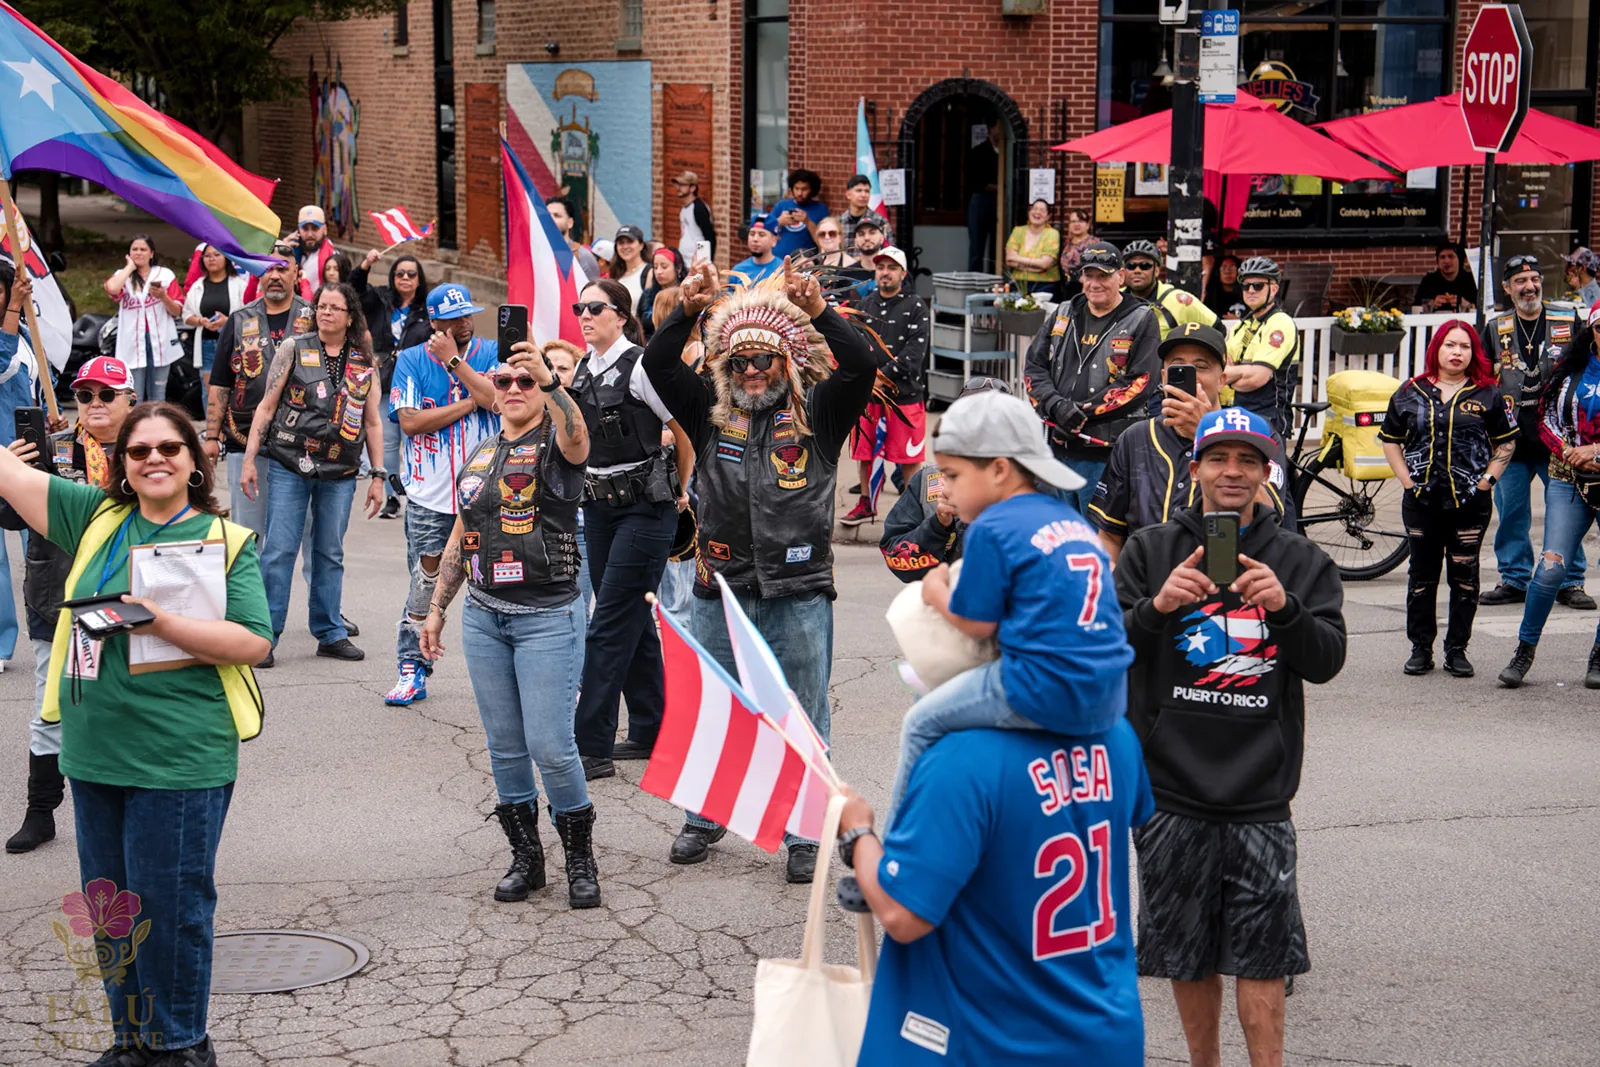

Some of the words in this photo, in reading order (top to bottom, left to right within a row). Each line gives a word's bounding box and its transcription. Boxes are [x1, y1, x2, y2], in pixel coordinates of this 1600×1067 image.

[1224, 14, 1235, 23] bus
[1224, 24, 1237, 33] stop
[1465, 51, 1516, 105] STOP
[1097, 179, 1122, 187] BOWL
[1250, 175, 1280, 192] PEN
[1243, 207, 1271, 218] akfast
[1279, 207, 1302, 217] Lunch
[1339, 207, 1370, 218] Catering
[1376, 207, 1402, 216] Private
[1402, 207, 1426, 216] Events
[1184, 322, 1200, 336] P
[1225, 409, 1250, 432] PR
[886, 553, 931, 570] ICAGO
[1066, 553, 1103, 626] 7
[80, 626, 95, 669] CURITY
[1173, 686, 1232, 705] PUERTO
[1232, 694, 1269, 708] RICO
[1028, 745, 1112, 816] SOSA
[1033, 819, 1117, 962] 21
